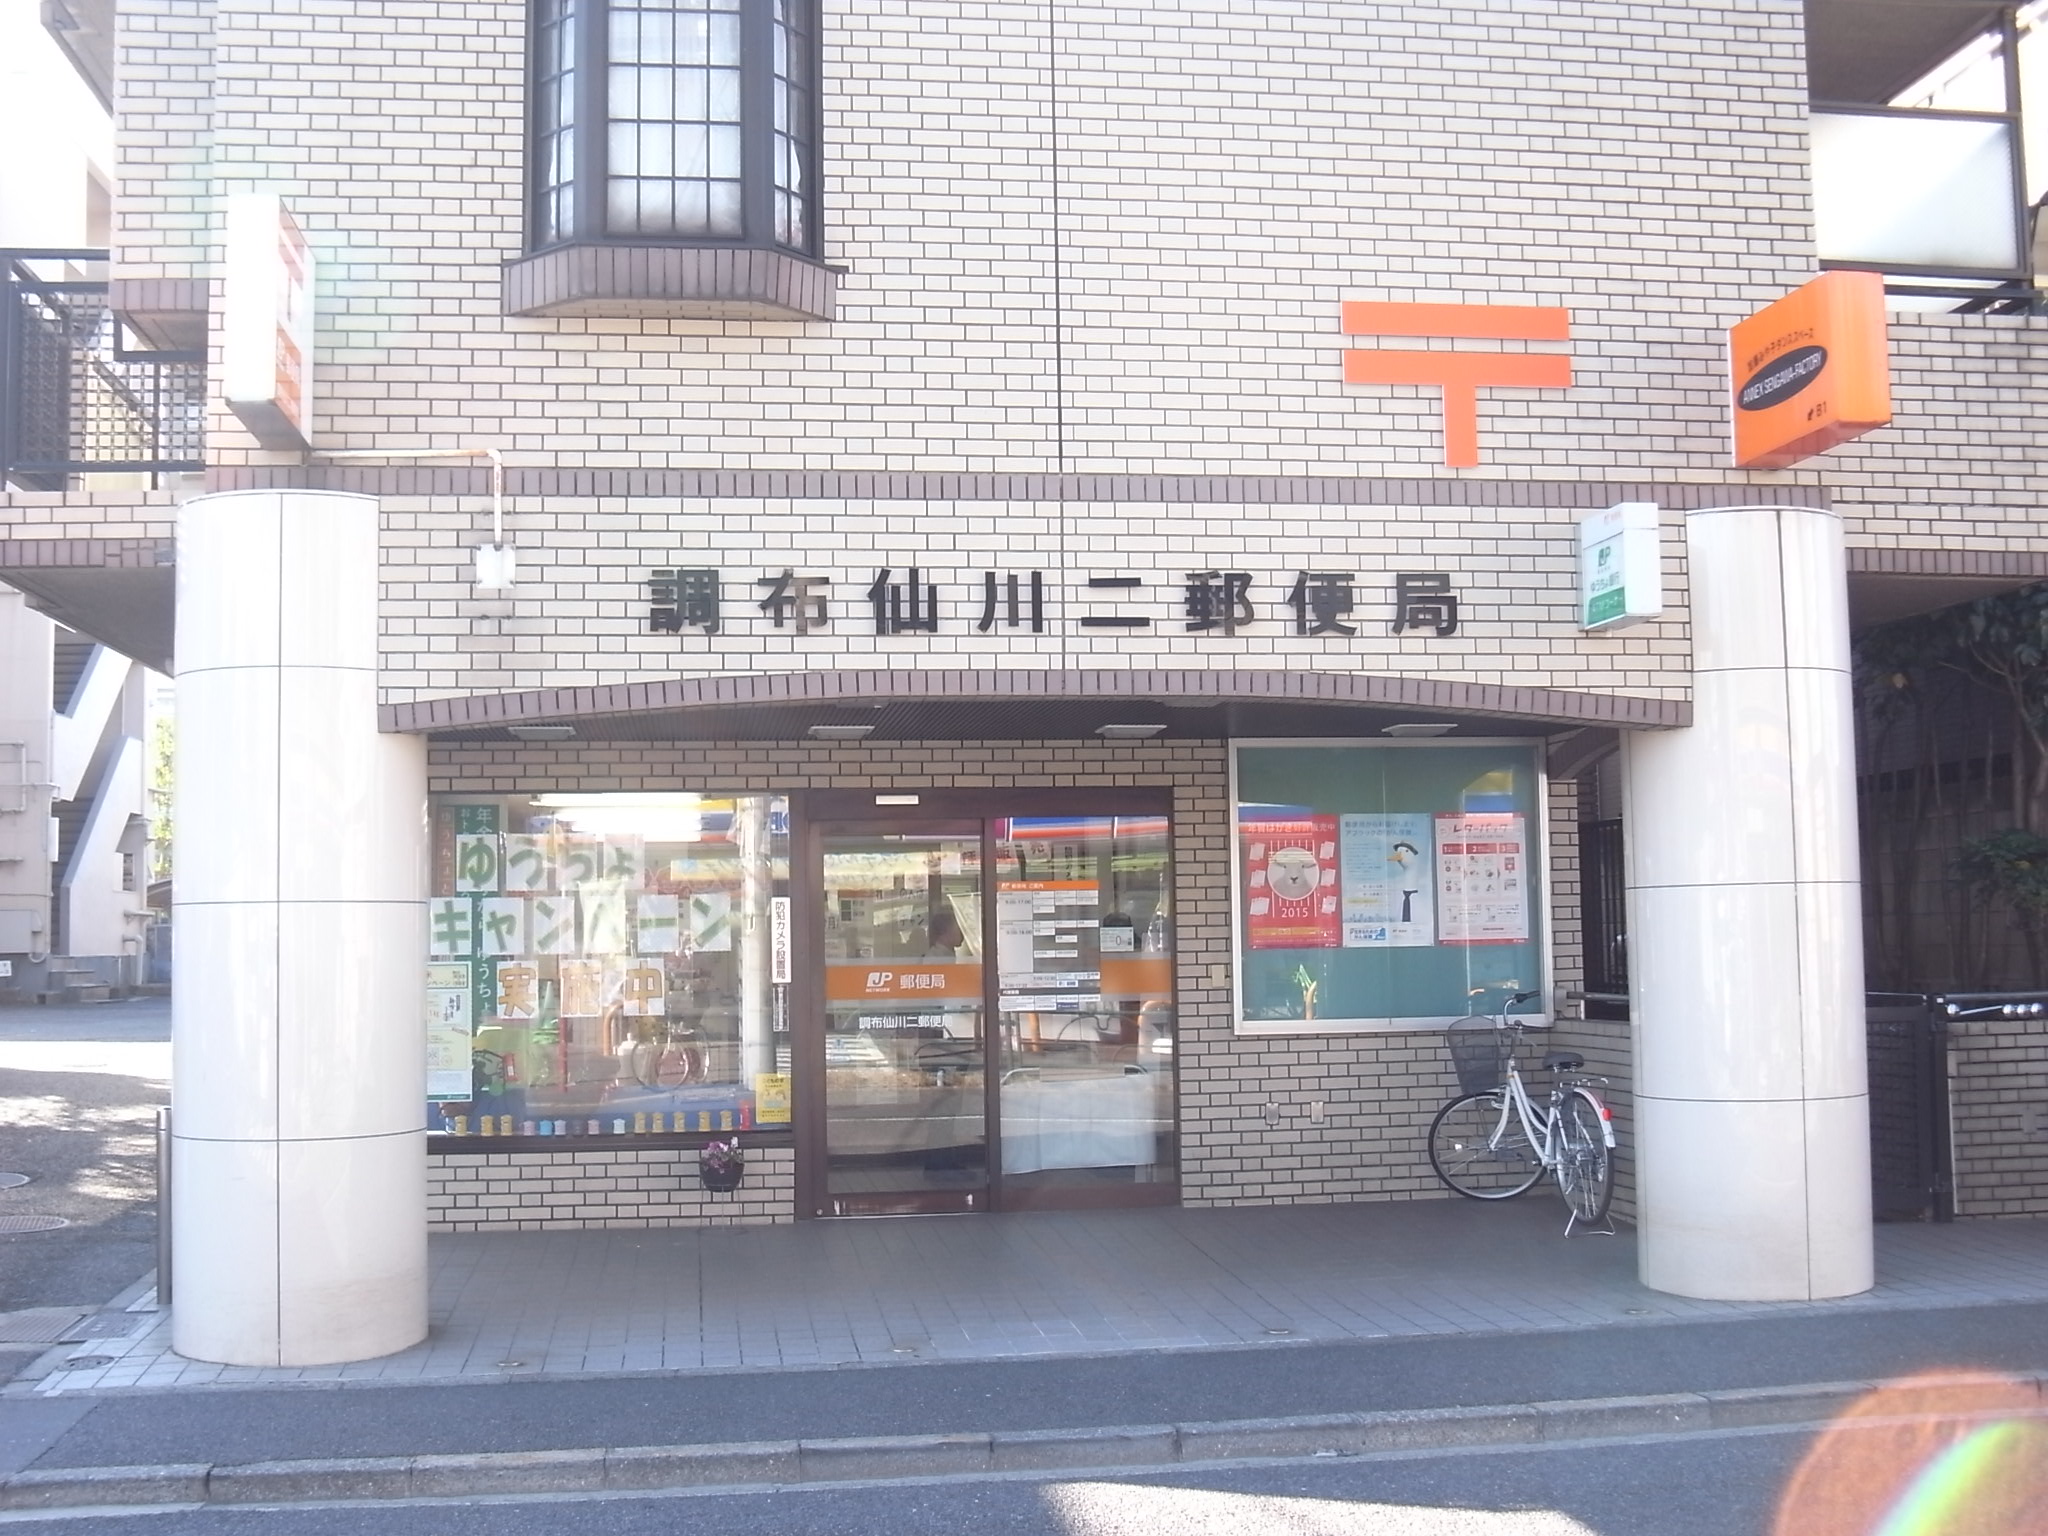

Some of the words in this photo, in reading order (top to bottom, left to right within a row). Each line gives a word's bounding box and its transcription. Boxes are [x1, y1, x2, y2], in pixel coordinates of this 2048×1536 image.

[1816, 401, 1827, 417] B1
[647, 568, 1461, 638] 調布仙川二郵便局
[458, 836, 636, 890] ゆうちょ
[433, 897, 730, 954] キャンペーン
[1281, 907, 1309, 918] 2015
[774, 901, 787, 980] 防犯カメラ設置局
[497, 960, 664, 1018] 実施中
[866, 971, 893, 987] JP
[899, 974, 946, 990] 郵便局
[858, 1015, 953, 1030] 調布仙川二郵便局
